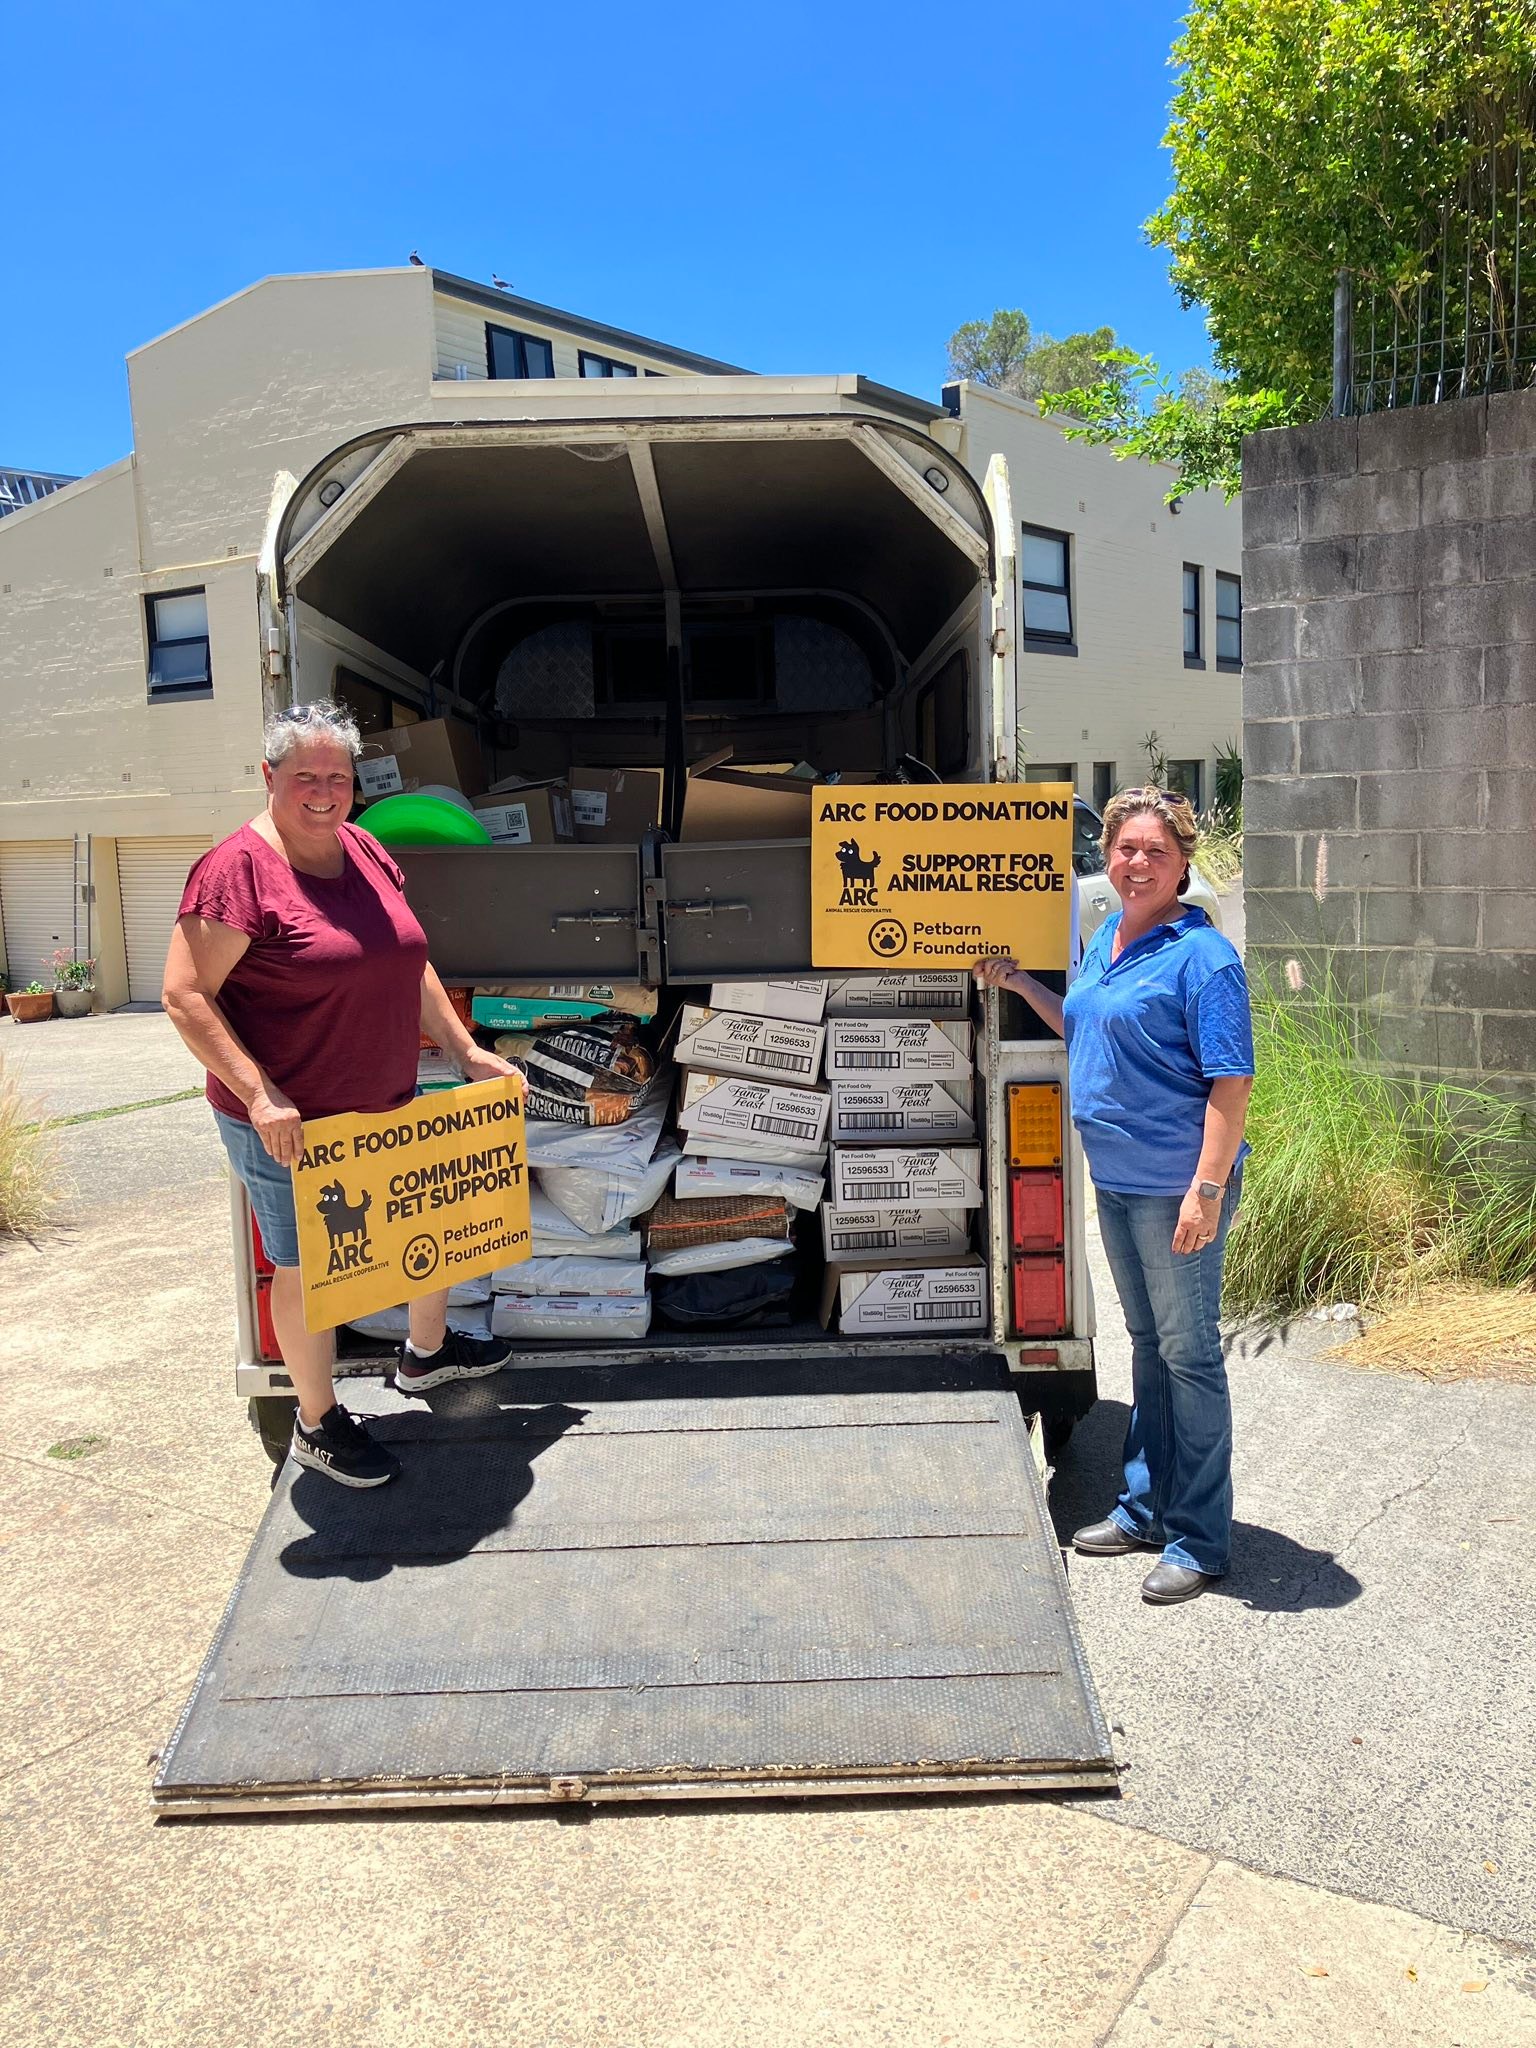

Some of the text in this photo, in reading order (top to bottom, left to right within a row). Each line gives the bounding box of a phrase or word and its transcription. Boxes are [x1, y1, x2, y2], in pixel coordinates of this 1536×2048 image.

[819, 801, 1068, 822] ARC FOOD DONATION
[902, 854, 1054, 872] SUPPORT FOR
[887, 874, 1065, 892] ANIMAL RESCUE
[839, 888, 878, 906] ARC
[913, 922, 981, 936] Petbarn
[913, 942, 1011, 955] Foundation
[876, 975, 907, 987] Feast
[918, 975, 958, 983] 12596533
[721, 1018, 760, 1035] Fancy
[889, 1025, 929, 1038] Fancy
[727, 1030, 759, 1043] Feast
[770, 1035, 810, 1048] 12596533
[839, 1035, 880, 1043] 12596533
[895, 1036, 928, 1048] Feast
[544, 1036, 600, 1061] PADDO
[728, 1084, 766, 1101] Fancy
[892, 1086, 932, 1099] Fancy
[527, 1093, 585, 1121] OCKMAN
[733, 1096, 765, 1110] Feast
[843, 1096, 884, 1105] 12596533
[899, 1097, 931, 1108] Feast
[776, 1102, 816, 1116] 12596533
[297, 1097, 520, 1171] ARC FOOD DONATION
[898, 1155, 939, 1168] Fancy
[389, 1142, 518, 1197] COMMUNITY
[847, 1166, 889, 1175] 12596533
[904, 1166, 937, 1178] Feast
[386, 1163, 524, 1223] PET SUPPORT
[835, 1215, 875, 1225] 12596533
[890, 1214, 922, 1227] Feast
[443, 1214, 504, 1244] Petbarn
[444, 1229, 529, 1266] Foundation
[327, 1238, 373, 1276] ARC
[311, 1260, 390, 1291] ANIMAL RESCUE COOPERATIVE
[882, 1277, 923, 1290] Fancy
[934, 1284, 975, 1294] 12596533
[890, 1287, 923, 1300] Feast
[295, 1433, 334, 1465] VERLAST
